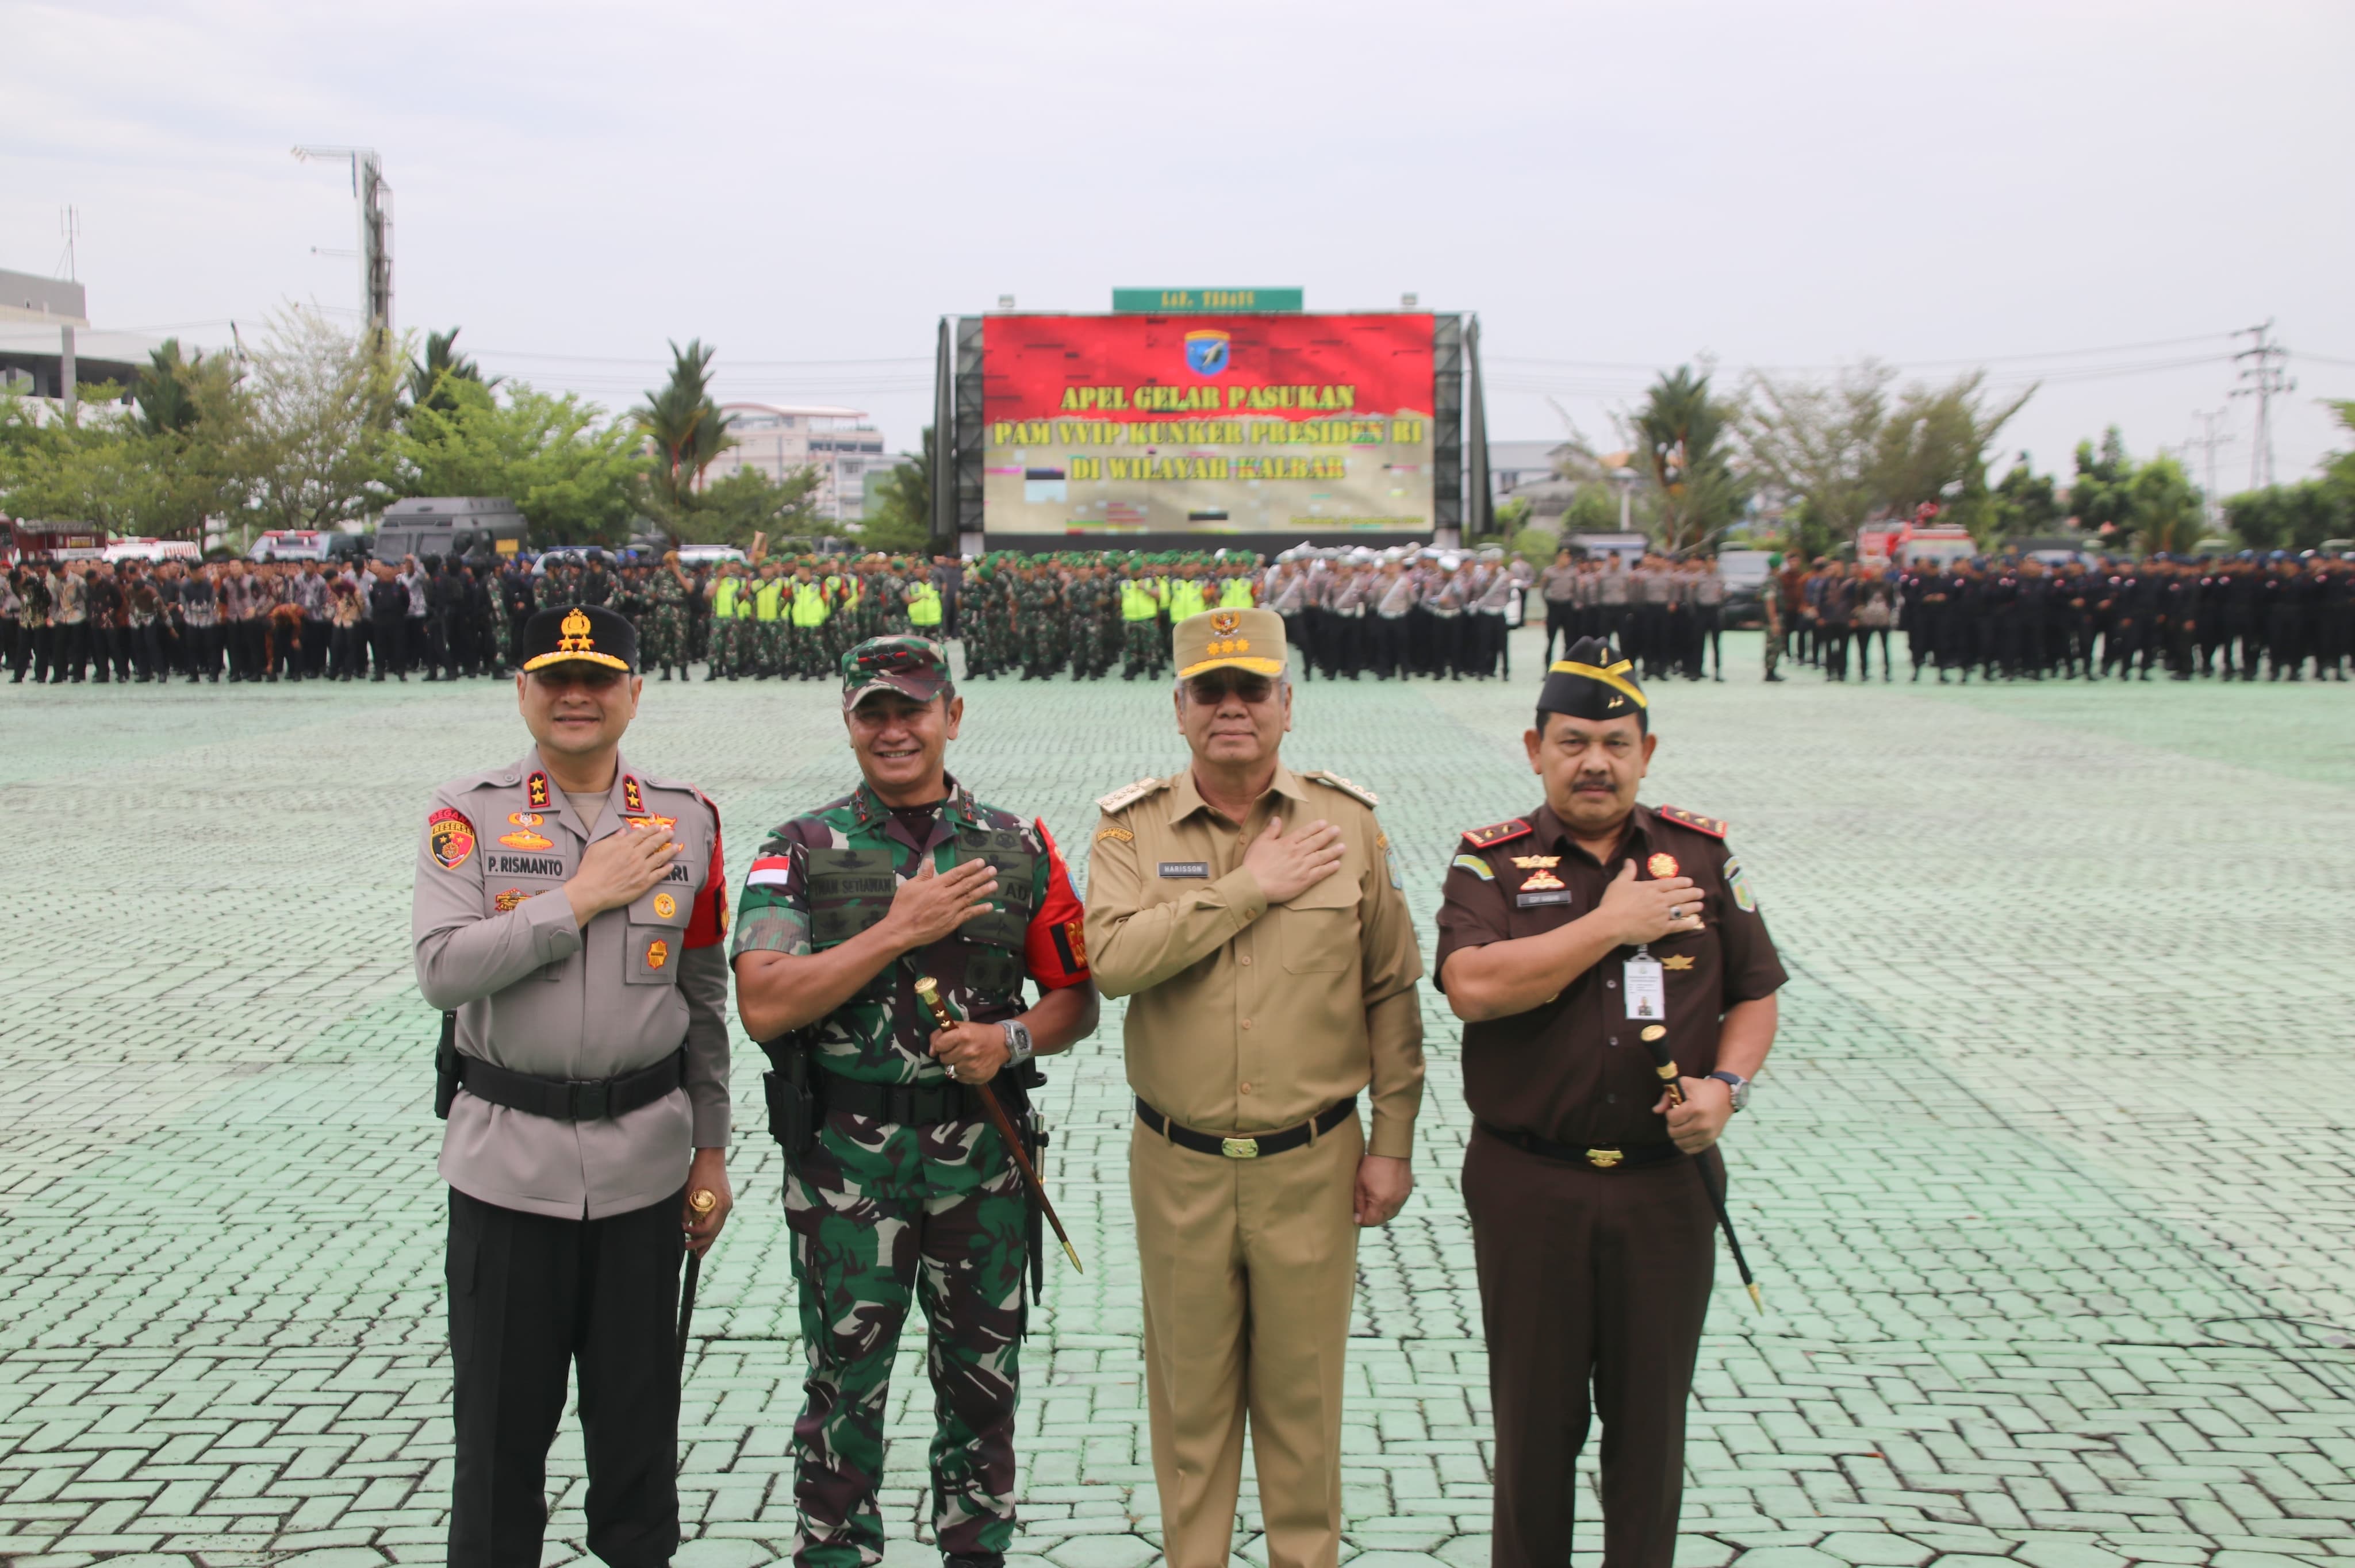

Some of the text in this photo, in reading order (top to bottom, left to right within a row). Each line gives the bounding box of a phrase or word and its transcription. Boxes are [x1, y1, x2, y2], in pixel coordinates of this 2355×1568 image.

[1061, 385, 1356, 410] APEL GELAR PASUKAN
[994, 420, 1422, 445] PAM VVIP KUNKER PRESIDEN RI
[1071, 456, 1346, 479] DI WILAYAH KALBAR
[489, 856, 563, 876] P. RISMANTO
[1006, 882, 1027, 901] AD
